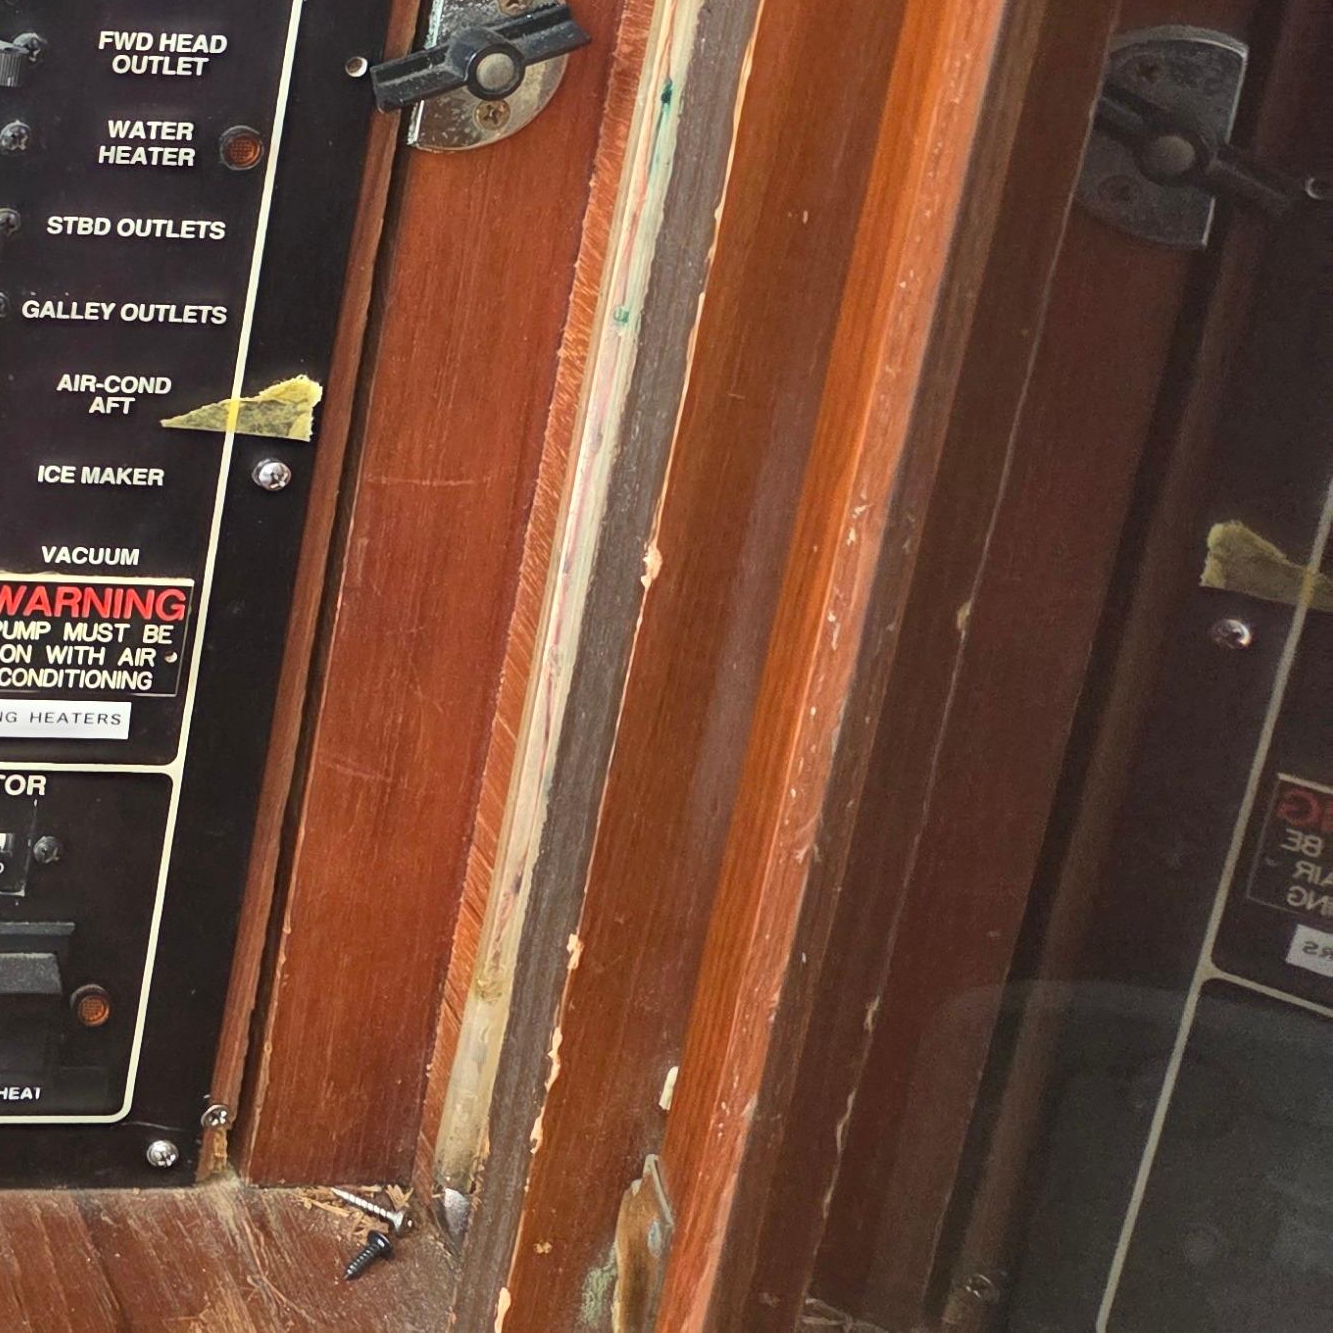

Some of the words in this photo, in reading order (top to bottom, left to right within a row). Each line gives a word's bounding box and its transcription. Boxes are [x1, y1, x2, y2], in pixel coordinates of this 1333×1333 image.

[108, 120, 193, 140] WATER
[99, 146, 195, 166] HEATER
[42, 546, 139, 565] VACUUM
[64, 622, 130, 642] MUST
[143, 624, 173, 644] BE
[0, 644, 32, 663] ON
[46, 645, 105, 665] WITH
[118, 648, 156, 667] AIR
[30, 712, 120, 725] HEATERS
